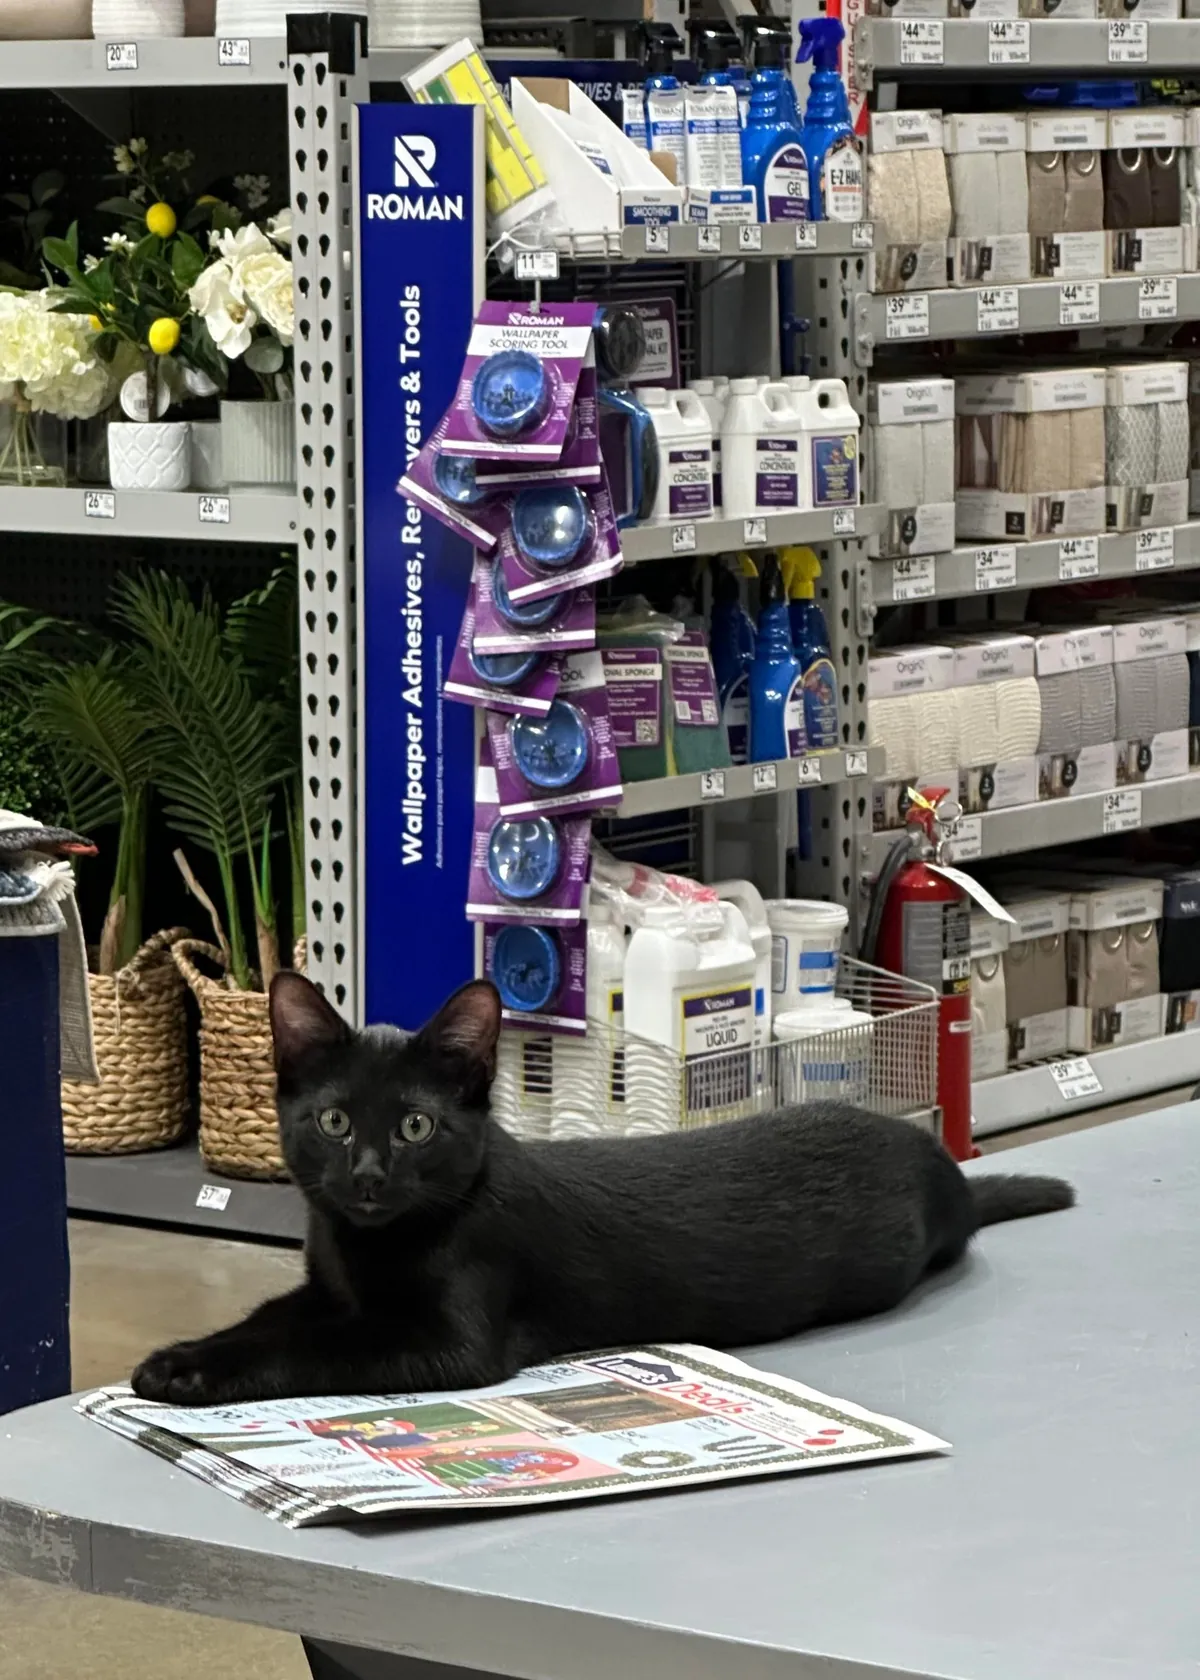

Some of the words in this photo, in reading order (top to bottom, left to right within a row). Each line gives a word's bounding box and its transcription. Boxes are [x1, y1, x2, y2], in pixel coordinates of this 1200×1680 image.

[787, 181, 803, 196] GEL
[367, 193, 464, 221] ROMAN
[632, 206, 672, 217] SMOOTHING
[399, 284, 421, 364] Tools
[520, 315, 564, 326] ROMAN
[502, 328, 560, 339] WALLPAPER
[489, 338, 539, 350] SCORING
[541, 340, 569, 350] TOOL
[401, 370, 421, 393] &
[401, 398, 422, 545] Revers
[401, 551, 426, 709] Adhesives,
[561, 669, 586, 682] OOL
[604, 669, 623, 677] OVAL
[625, 668, 655, 677] SPONGE
[401, 712, 427, 866] Wallpaper
[706, 1028, 738, 1047] LIQUID
[658, 1383, 755, 1414] Deals
